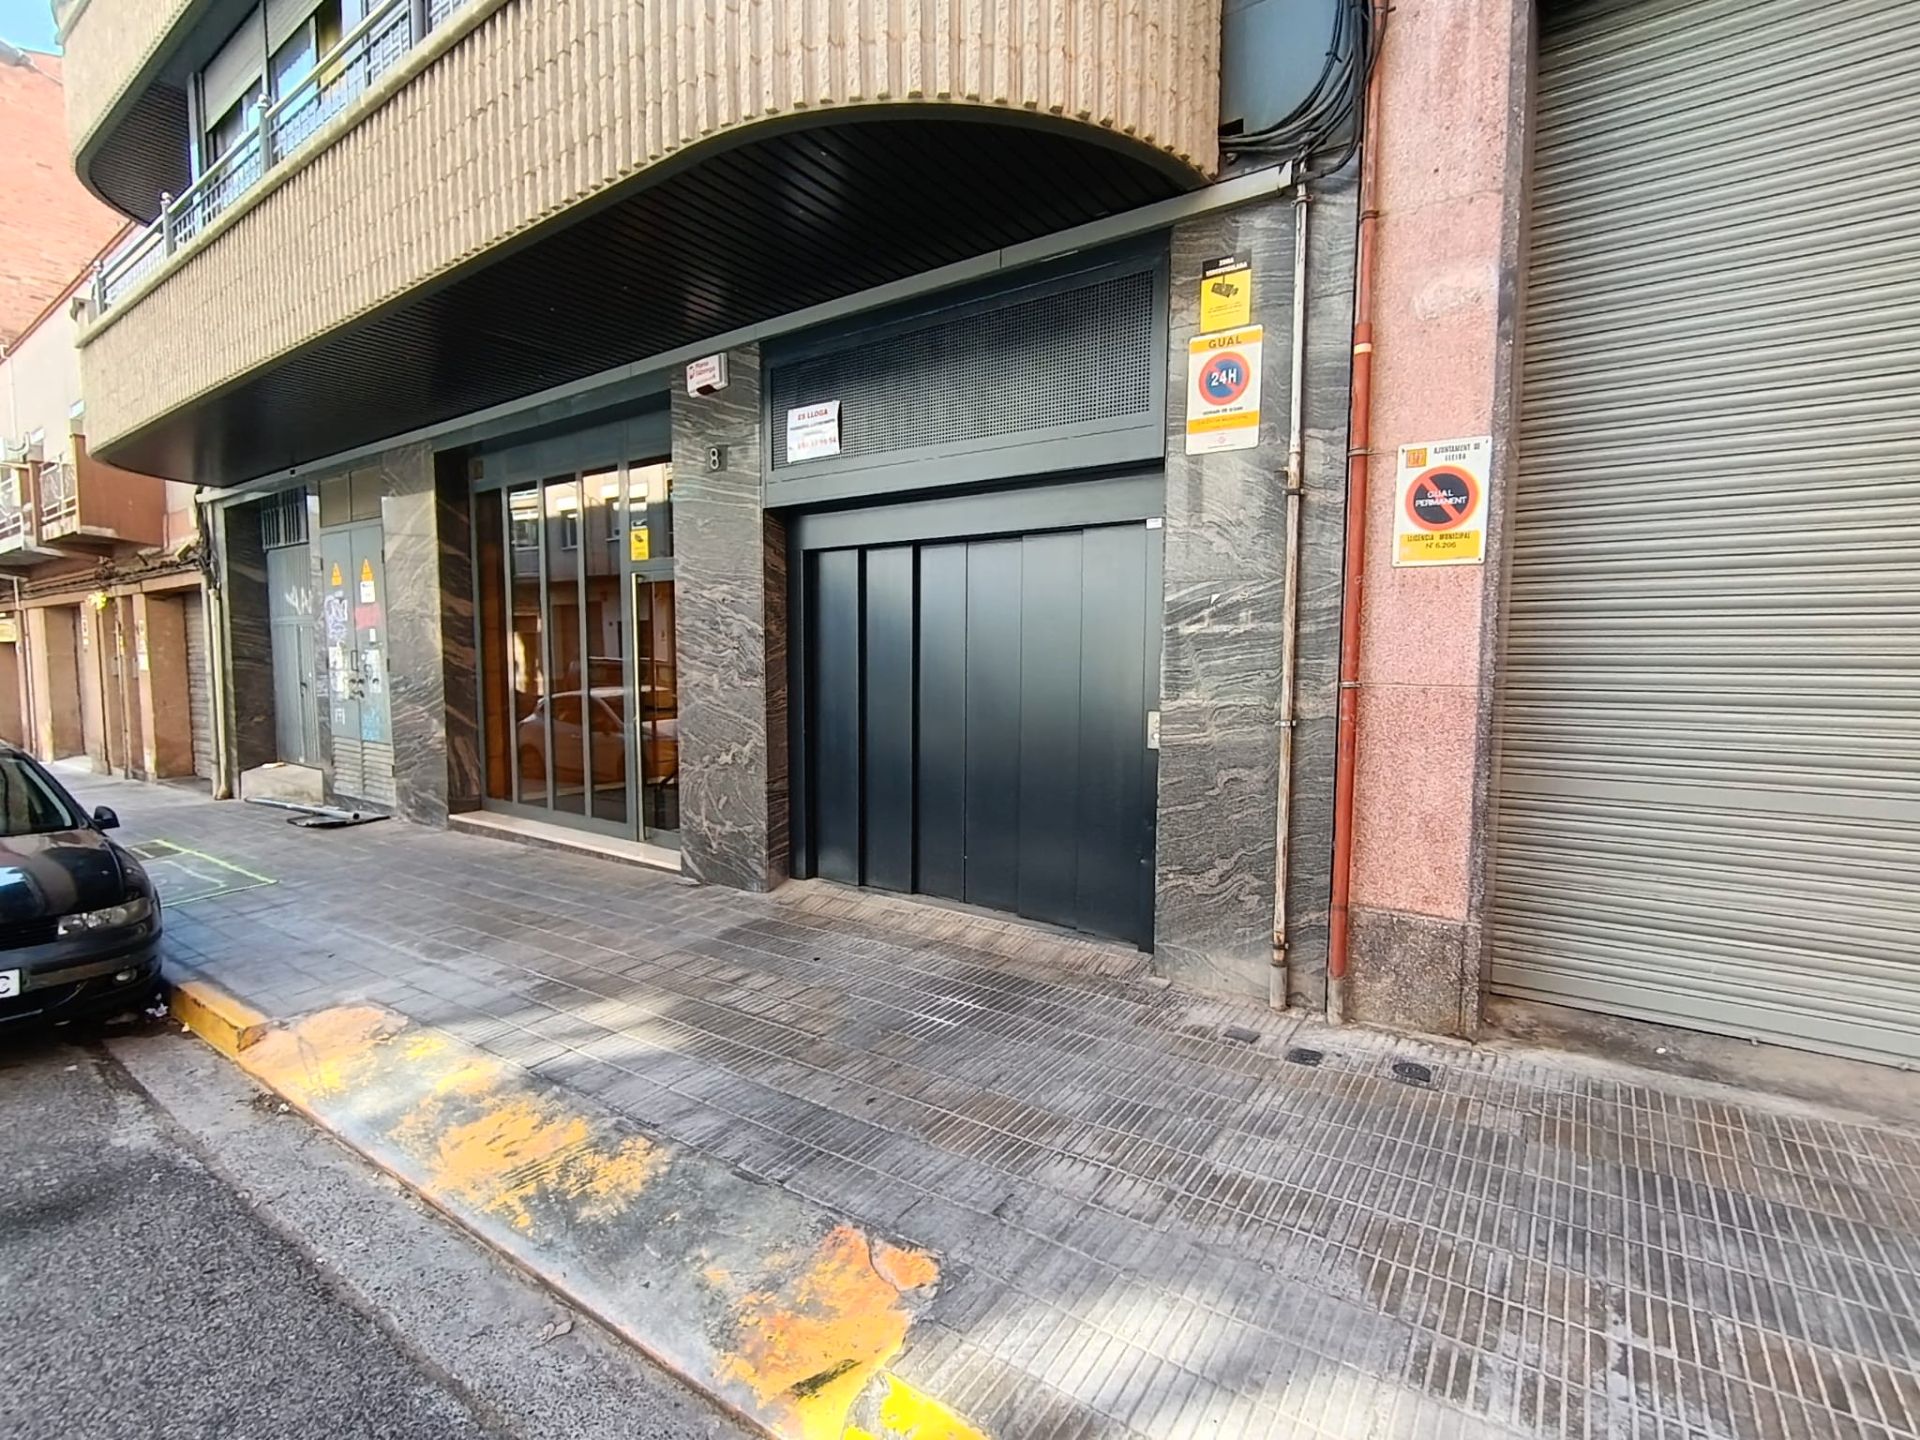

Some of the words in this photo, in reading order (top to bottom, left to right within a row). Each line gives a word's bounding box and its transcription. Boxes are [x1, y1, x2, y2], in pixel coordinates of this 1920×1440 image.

[1208, 336, 1242, 349] GUAL
[1210, 367, 1238, 387] 24H
[807, 408, 828, 418] LLOGA
[709, 448, 719, 470] 8
[1427, 489, 1454, 498] GUAL
[1415, 496, 1467, 507] PERMANENT
